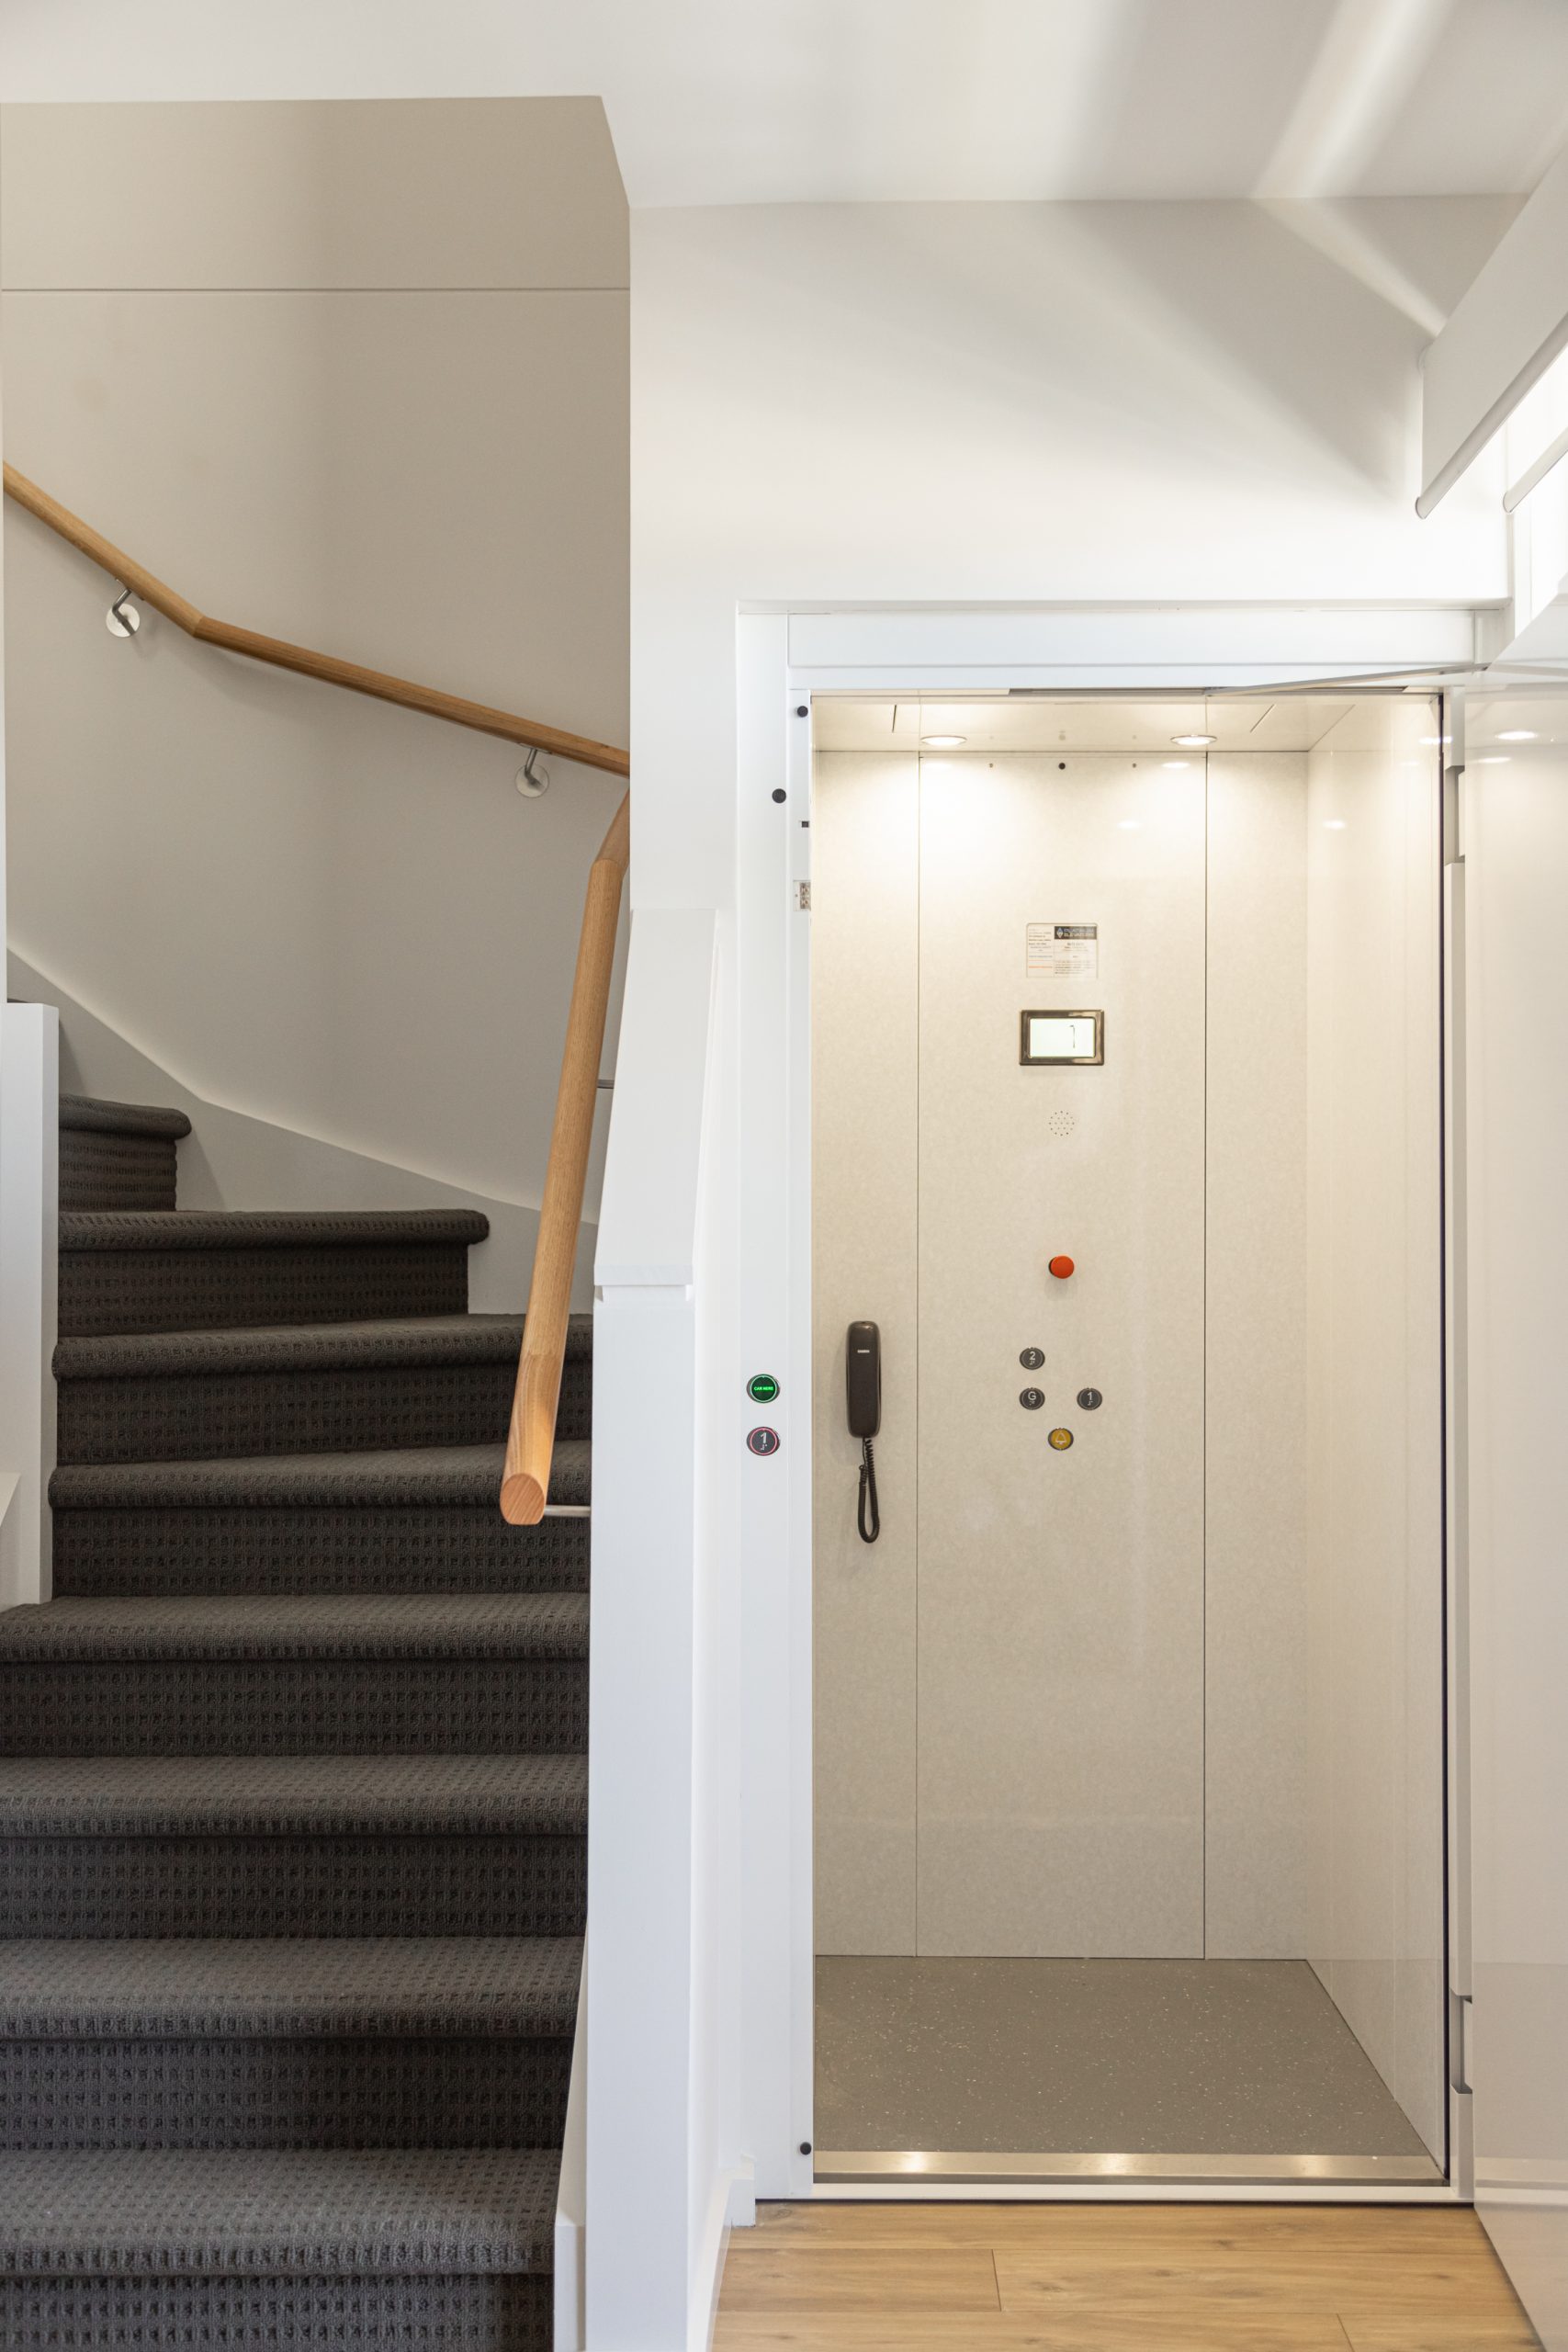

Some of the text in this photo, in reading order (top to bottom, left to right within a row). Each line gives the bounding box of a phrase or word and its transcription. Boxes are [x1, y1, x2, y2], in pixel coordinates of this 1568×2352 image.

[1029, 1351, 1036, 1361] 2
[1027, 1391, 1037, 1401] G
[1087, 1391, 1093, 1401] 1
[760, 1432, 767, 1444] 1
